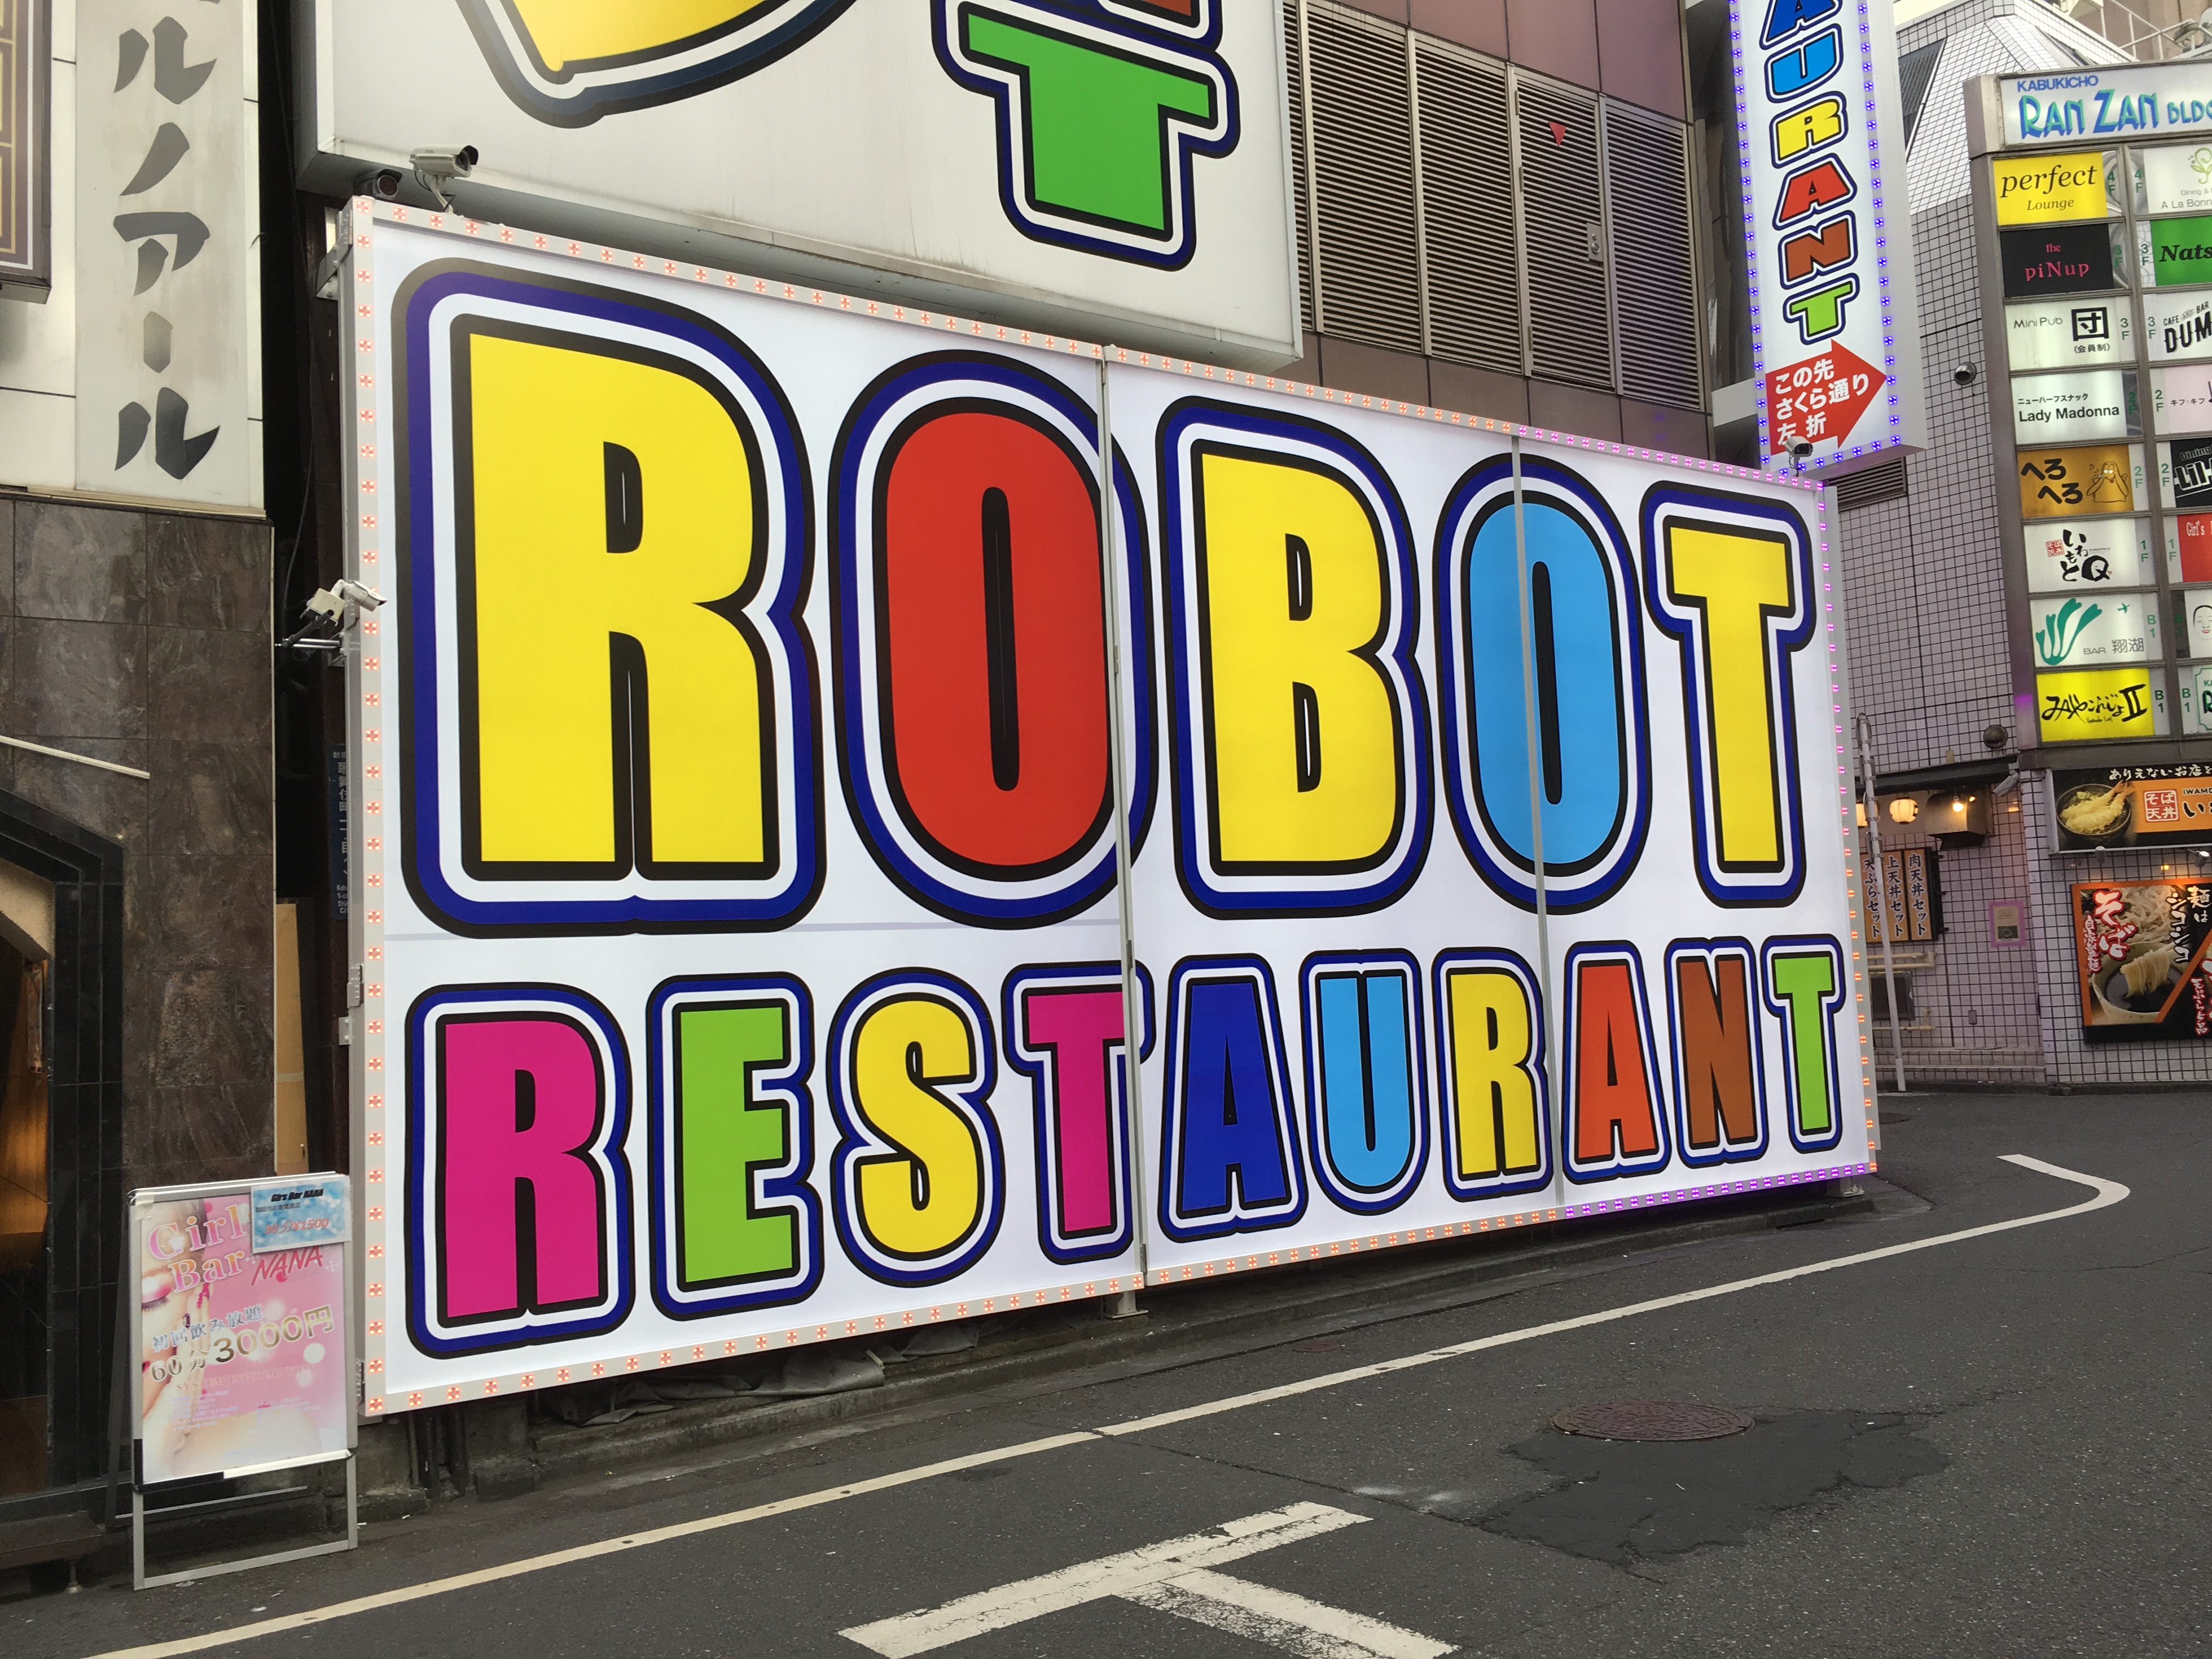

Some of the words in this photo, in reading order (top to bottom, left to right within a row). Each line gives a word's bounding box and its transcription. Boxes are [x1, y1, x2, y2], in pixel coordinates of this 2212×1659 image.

[2017, 75, 2098, 92] KABUKICHO
[2000, 165, 2097, 198] perfect
[2027, 198, 2074, 211] Lounge
[2162, 201, 2168, 209] A
[2171, 200, 2183, 208] La
[113, 16, 221, 479] ルノアール
[2046, 244, 2061, 252] the
[2159, 244, 2212, 262] Nats
[2013, 319, 2038, 329] Mini
[2040, 317, 2063, 326] Pub
[2071, 307, 2109, 341] 団
[2164, 315, 2180, 326] CAFE
[2196, 301, 2209, 314] BAR
[1776, 358, 1834, 394] この先
[1776, 374, 1869, 420] さくら通り
[2017, 393, 2089, 405] ニューハーフスナック
[2019, 410, 2051, 423] Lady
[2056, 405, 2119, 419] Madonna
[2180, 447, 2211, 461] Dining
[400, 262, 1816, 936] ROBOT
[1887, 856, 1904, 938] 上天丼セット
[1909, 854, 1927, 936] 肉天丼セット
[2094, 890, 2137, 960] そば
[2165, 891, 2191, 963] シコシコ
[405, 934, 1844, 1356] RESTAURANT
[167, 1251, 245, 1293] Bar
[251, 1246, 323, 1285] NANA
[152, 1304, 263, 1352] 初回飲み放題
